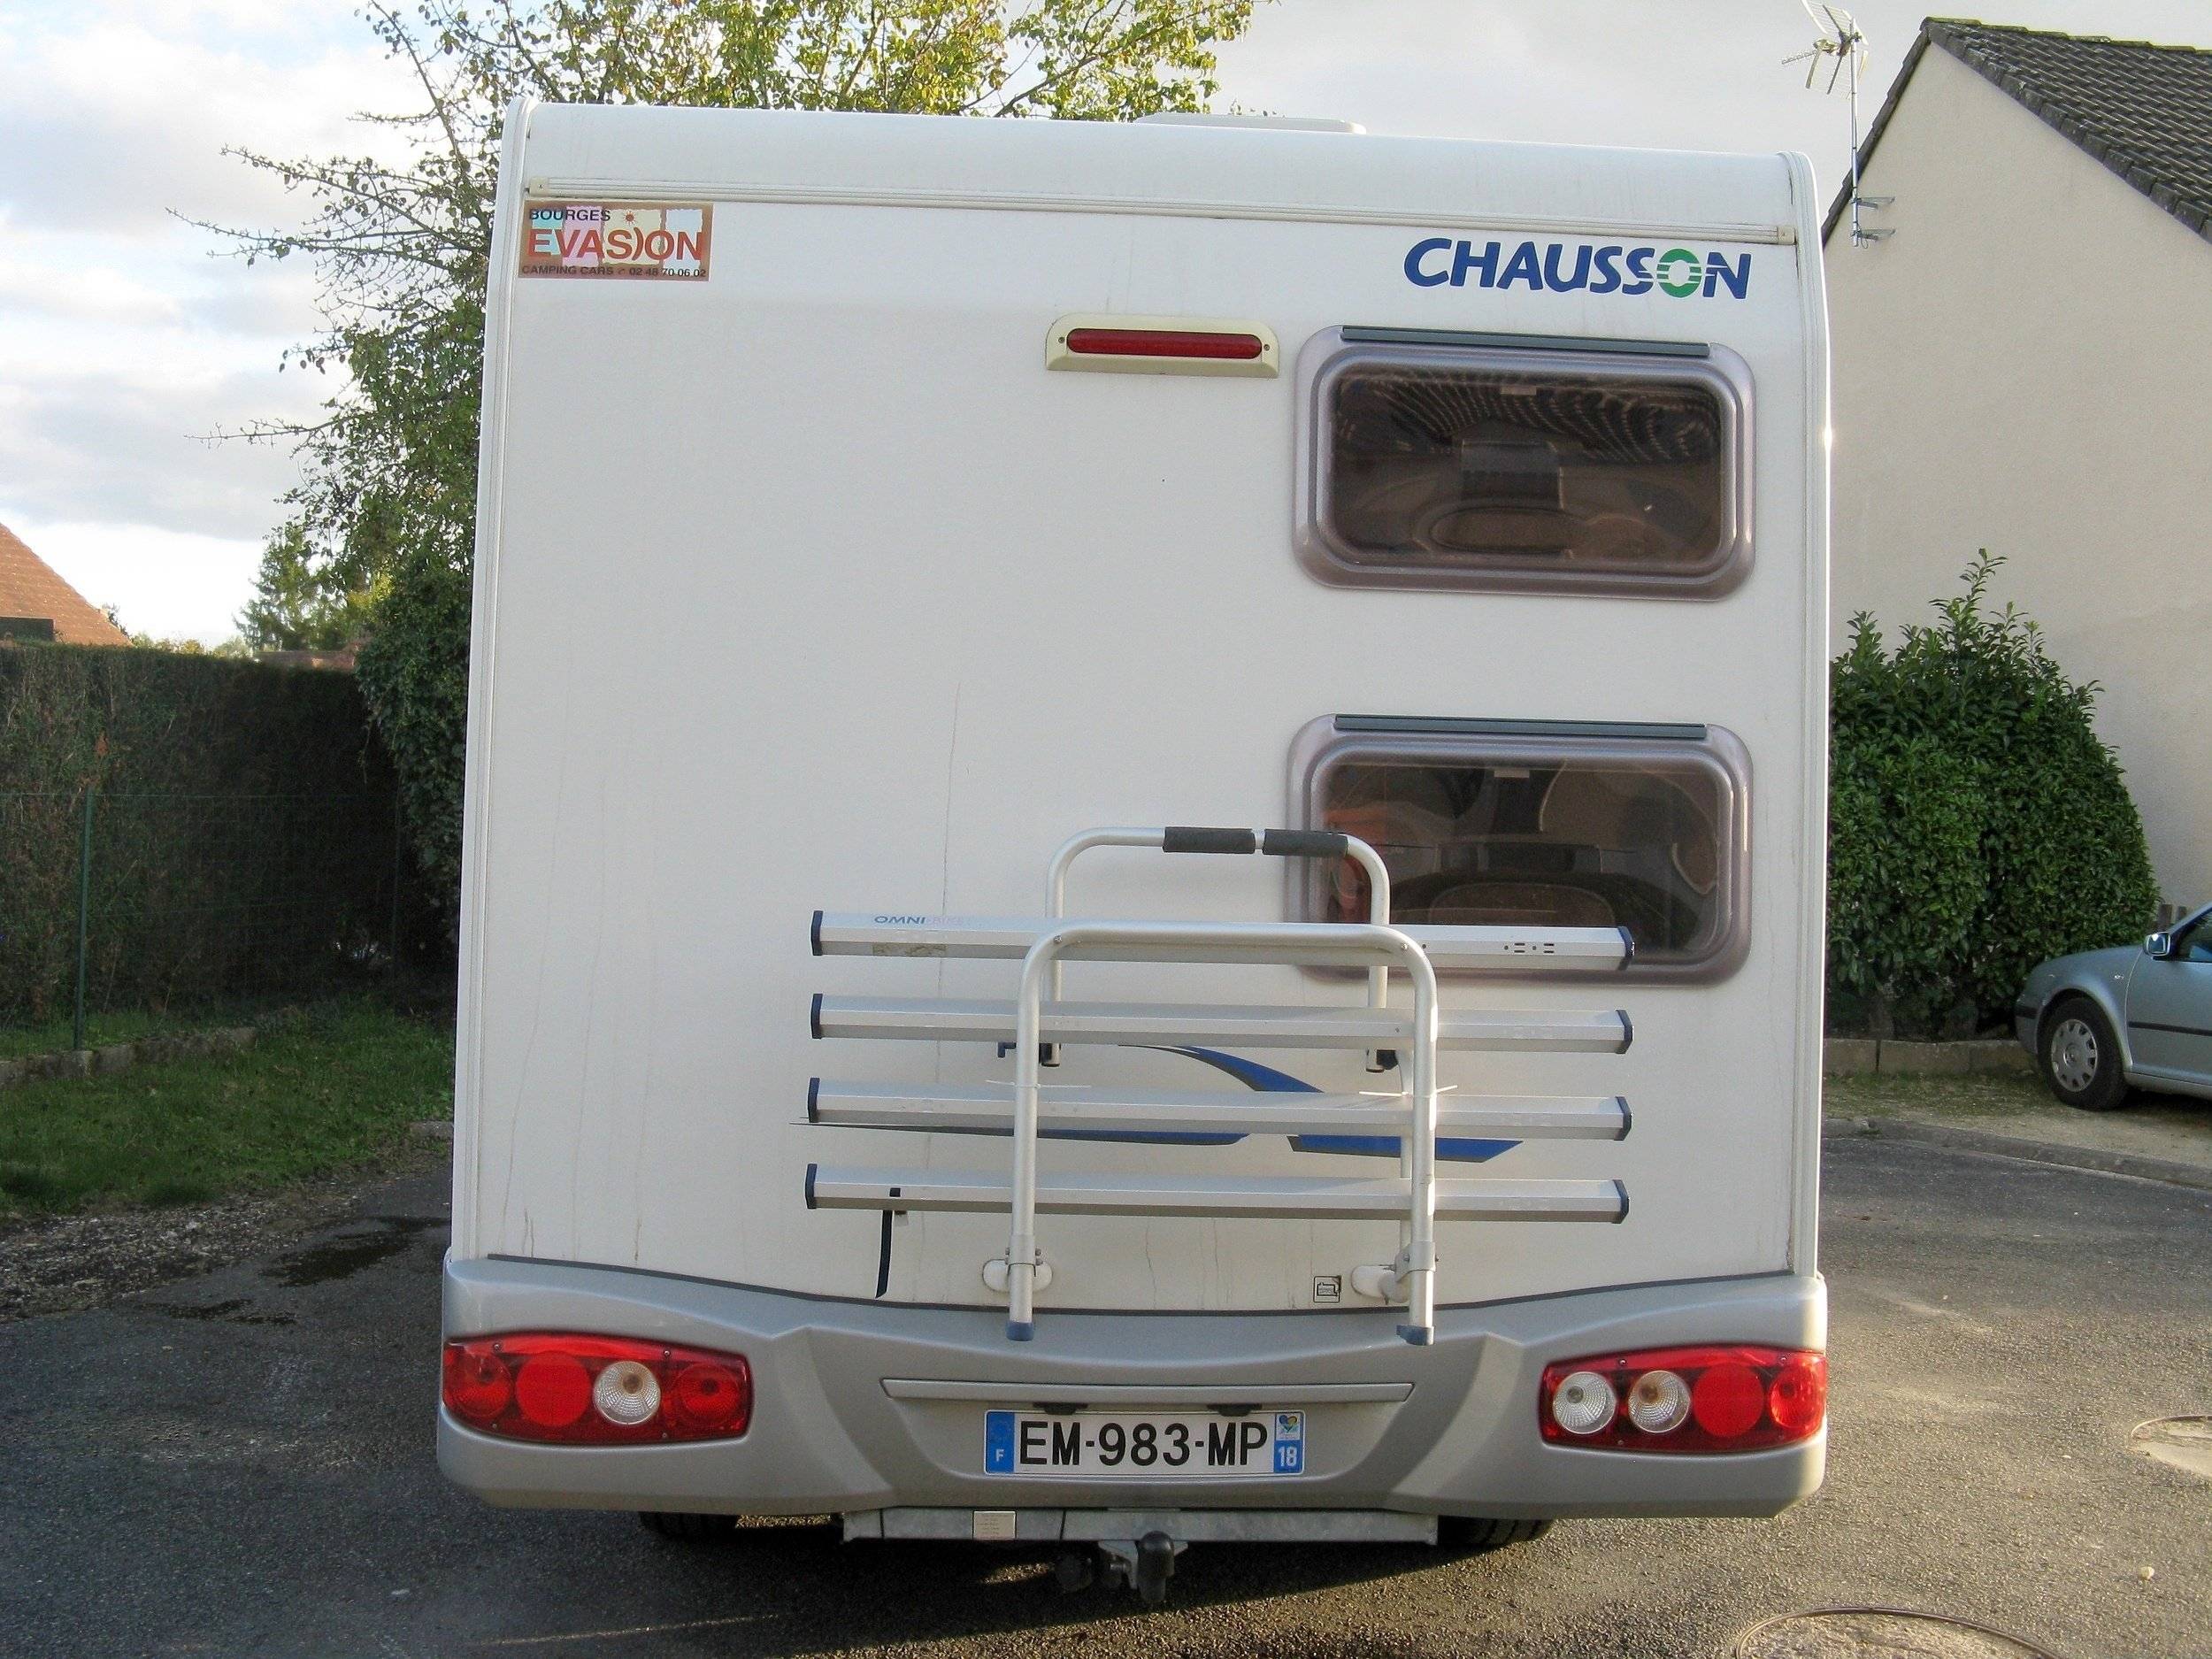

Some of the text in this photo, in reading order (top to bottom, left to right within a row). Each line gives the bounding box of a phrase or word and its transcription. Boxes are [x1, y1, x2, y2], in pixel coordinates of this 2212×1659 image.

[530, 208, 611, 221] BOURGES
[521, 265, 577, 275] CAMPING
[580, 266, 614, 276] CARS
[629, 267, 643, 277] 02
[677, 268, 690, 278] 06
[693, 269, 706, 278] 02
[1403, 237, 1752, 300] CHAUSSON
[873, 915, 926, 925] OMNI
[1019, 1421, 1268, 1467] EM-983-MP
[995, 1449, 1005, 1463] F
[1278, 1445, 1299, 1468] 18
